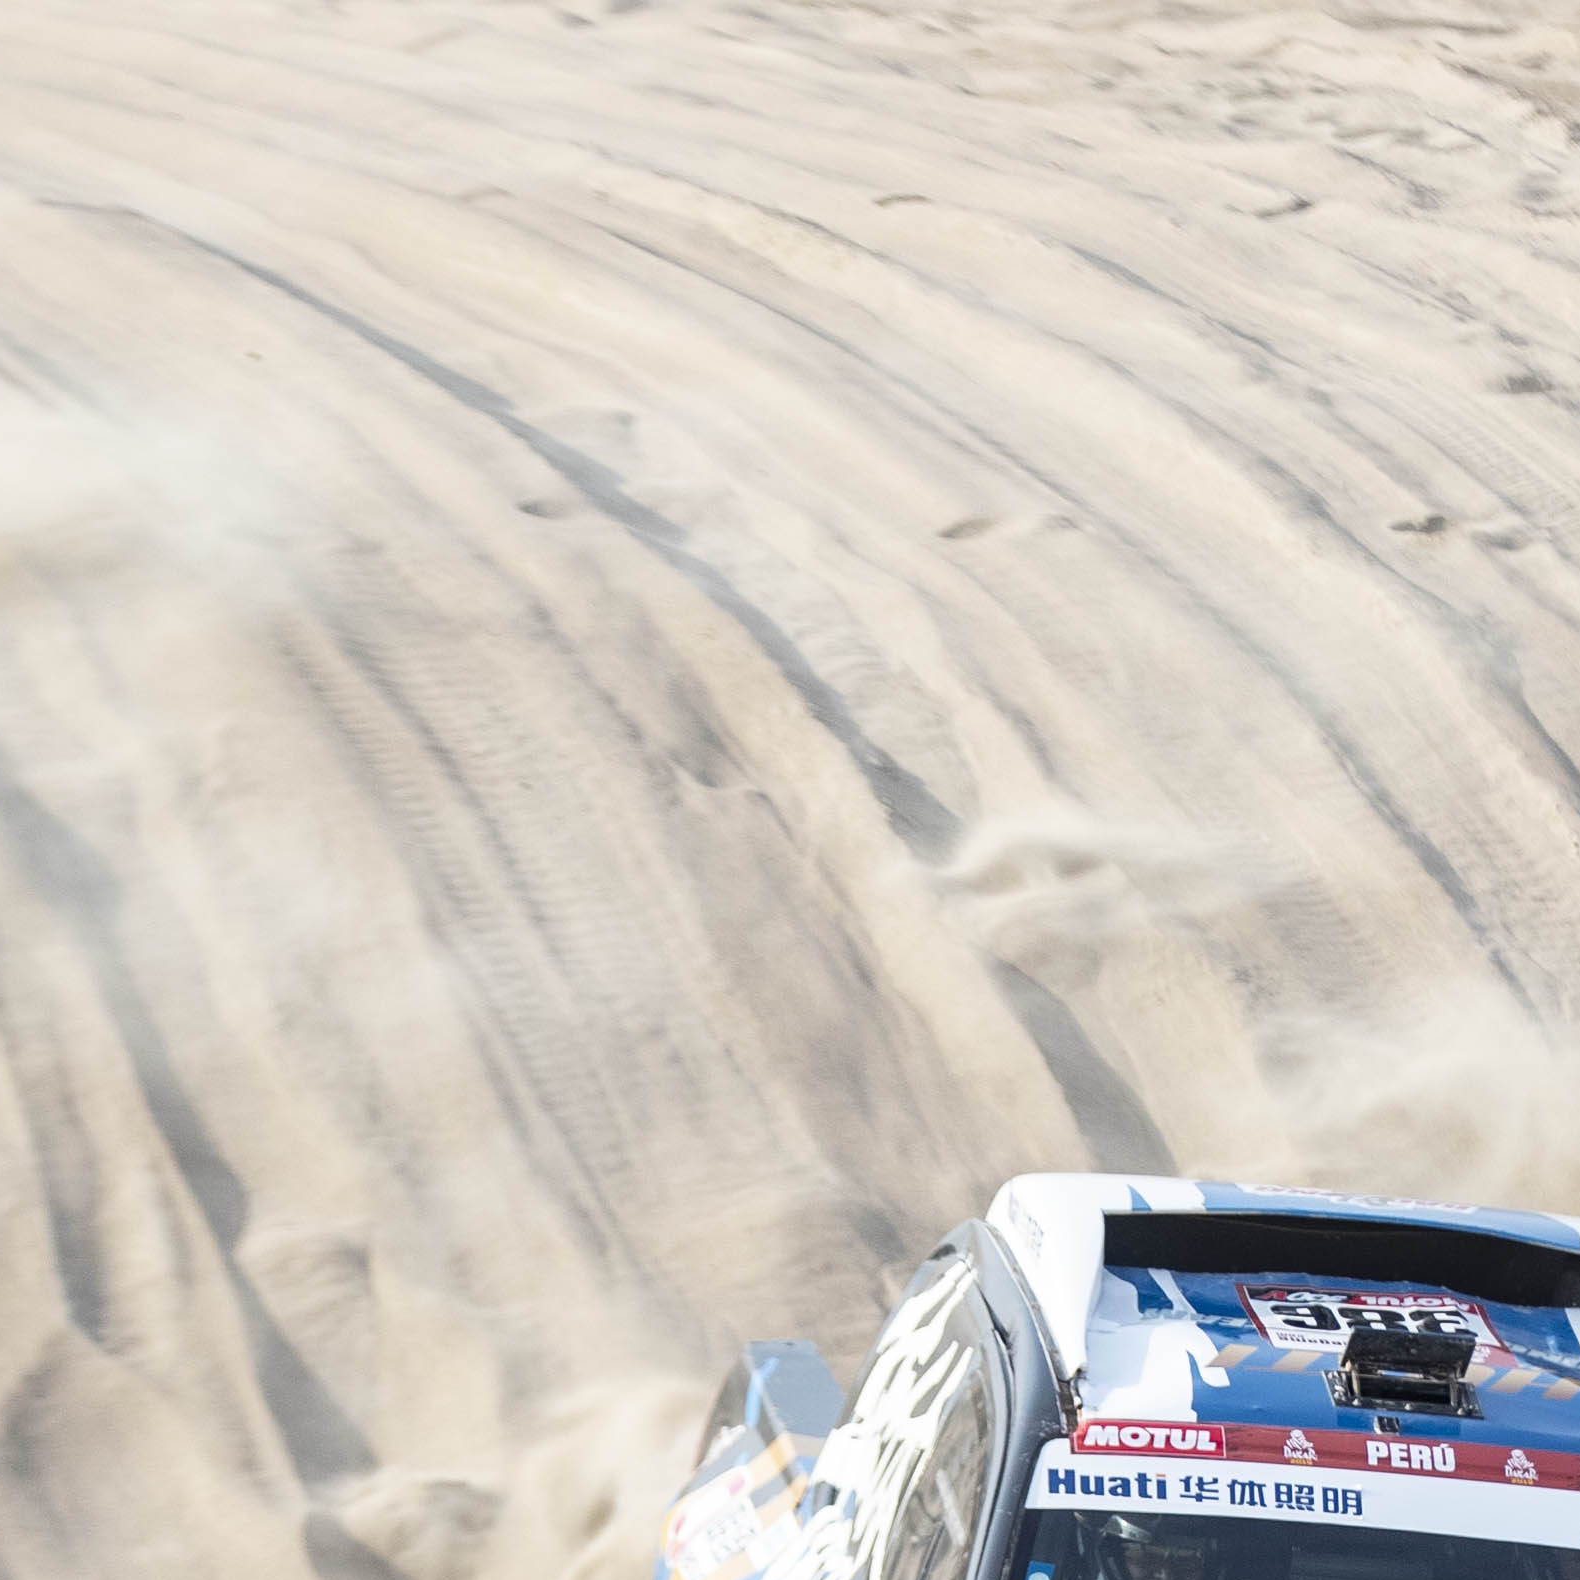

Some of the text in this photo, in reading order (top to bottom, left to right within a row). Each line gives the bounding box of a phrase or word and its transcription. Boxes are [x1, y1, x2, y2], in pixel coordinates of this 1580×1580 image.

[1083, 1425, 1218, 1452] MOTUL
[1365, 1438, 1457, 1472] PERÚ
[1047, 1468, 1364, 1517] Huati 华体照明
